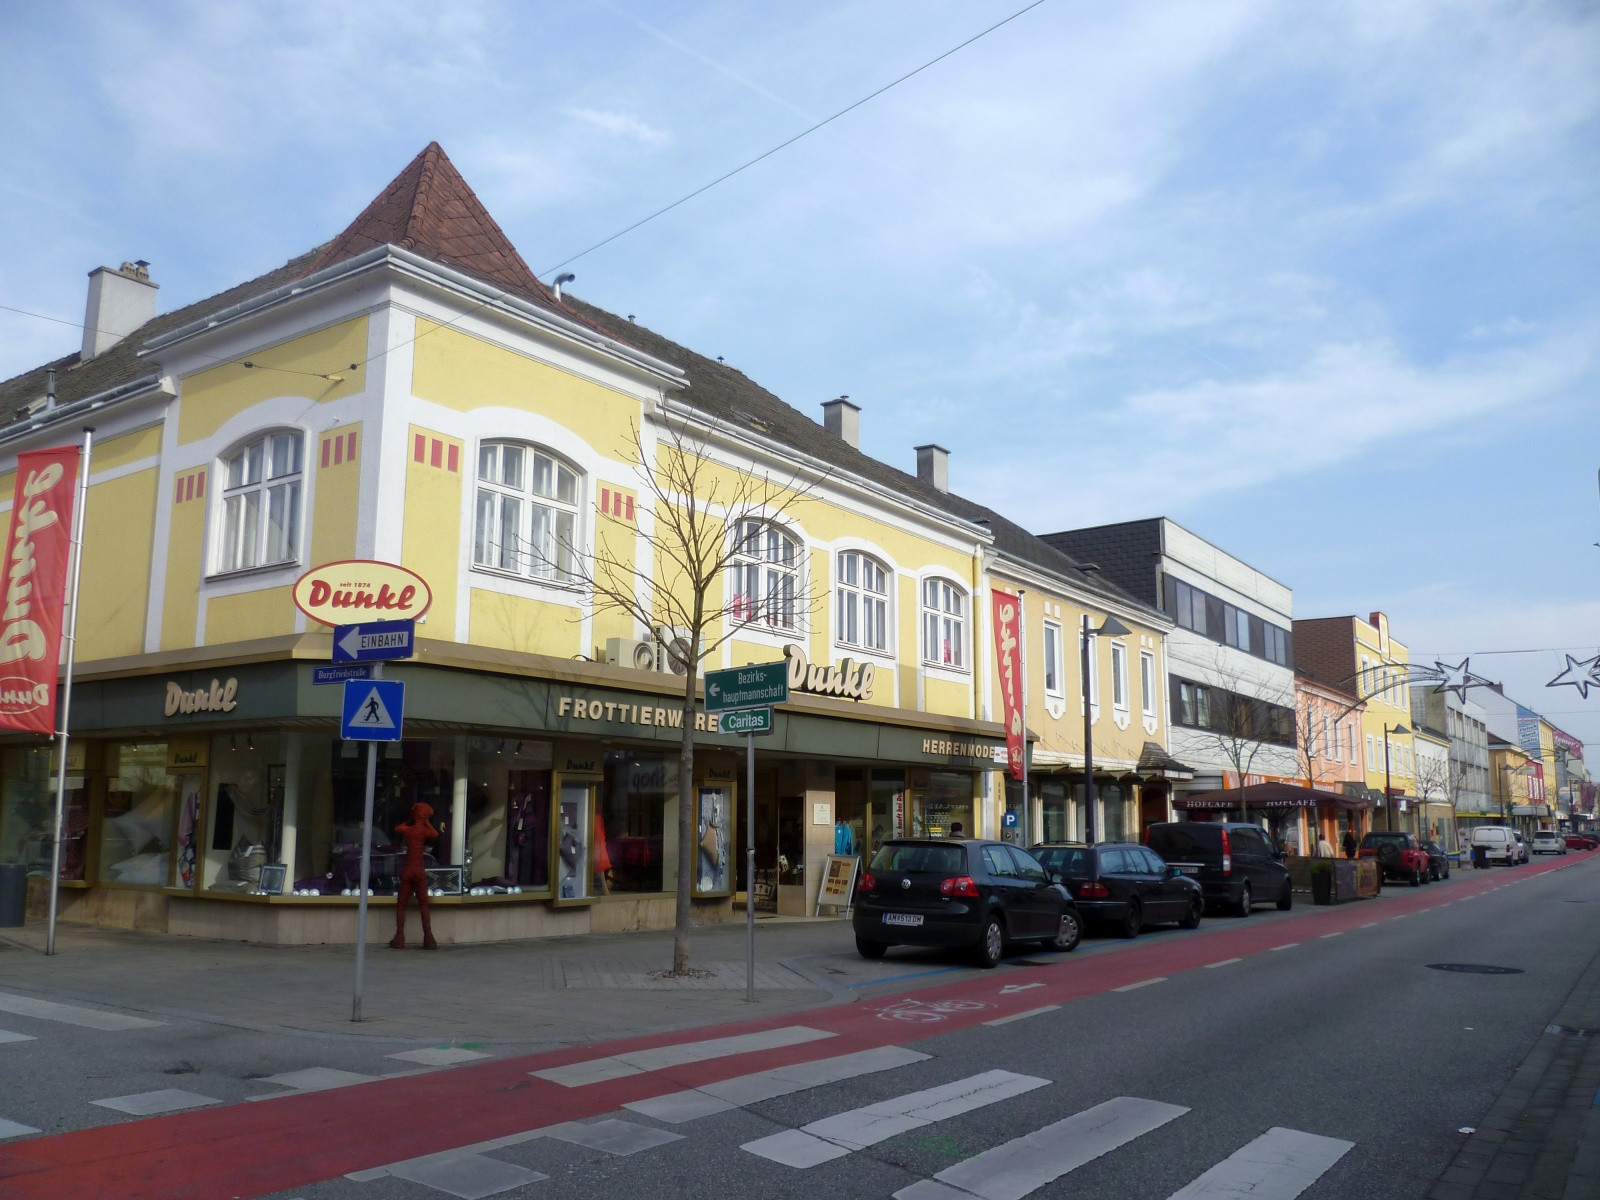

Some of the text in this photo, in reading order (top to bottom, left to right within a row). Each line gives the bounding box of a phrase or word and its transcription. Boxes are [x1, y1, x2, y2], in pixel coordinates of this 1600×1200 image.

[309, 579, 416, 611] Dunkl
[361, 634, 404, 649] EINBAHN
[318, 667, 367, 681] Burgfriedstraße
[738, 669, 767, 685] Bezirks-
[783, 643, 875, 700] Dunkl
[164, 677, 238, 717] Dunkl
[722, 685, 784, 706] hauptmannschaft
[558, 696, 719, 732] FROTTIERWRE
[728, 714, 764, 729] Caritas
[922, 738, 995, 759] HERRENMODE
[1006, 815, 1015, 826] P
